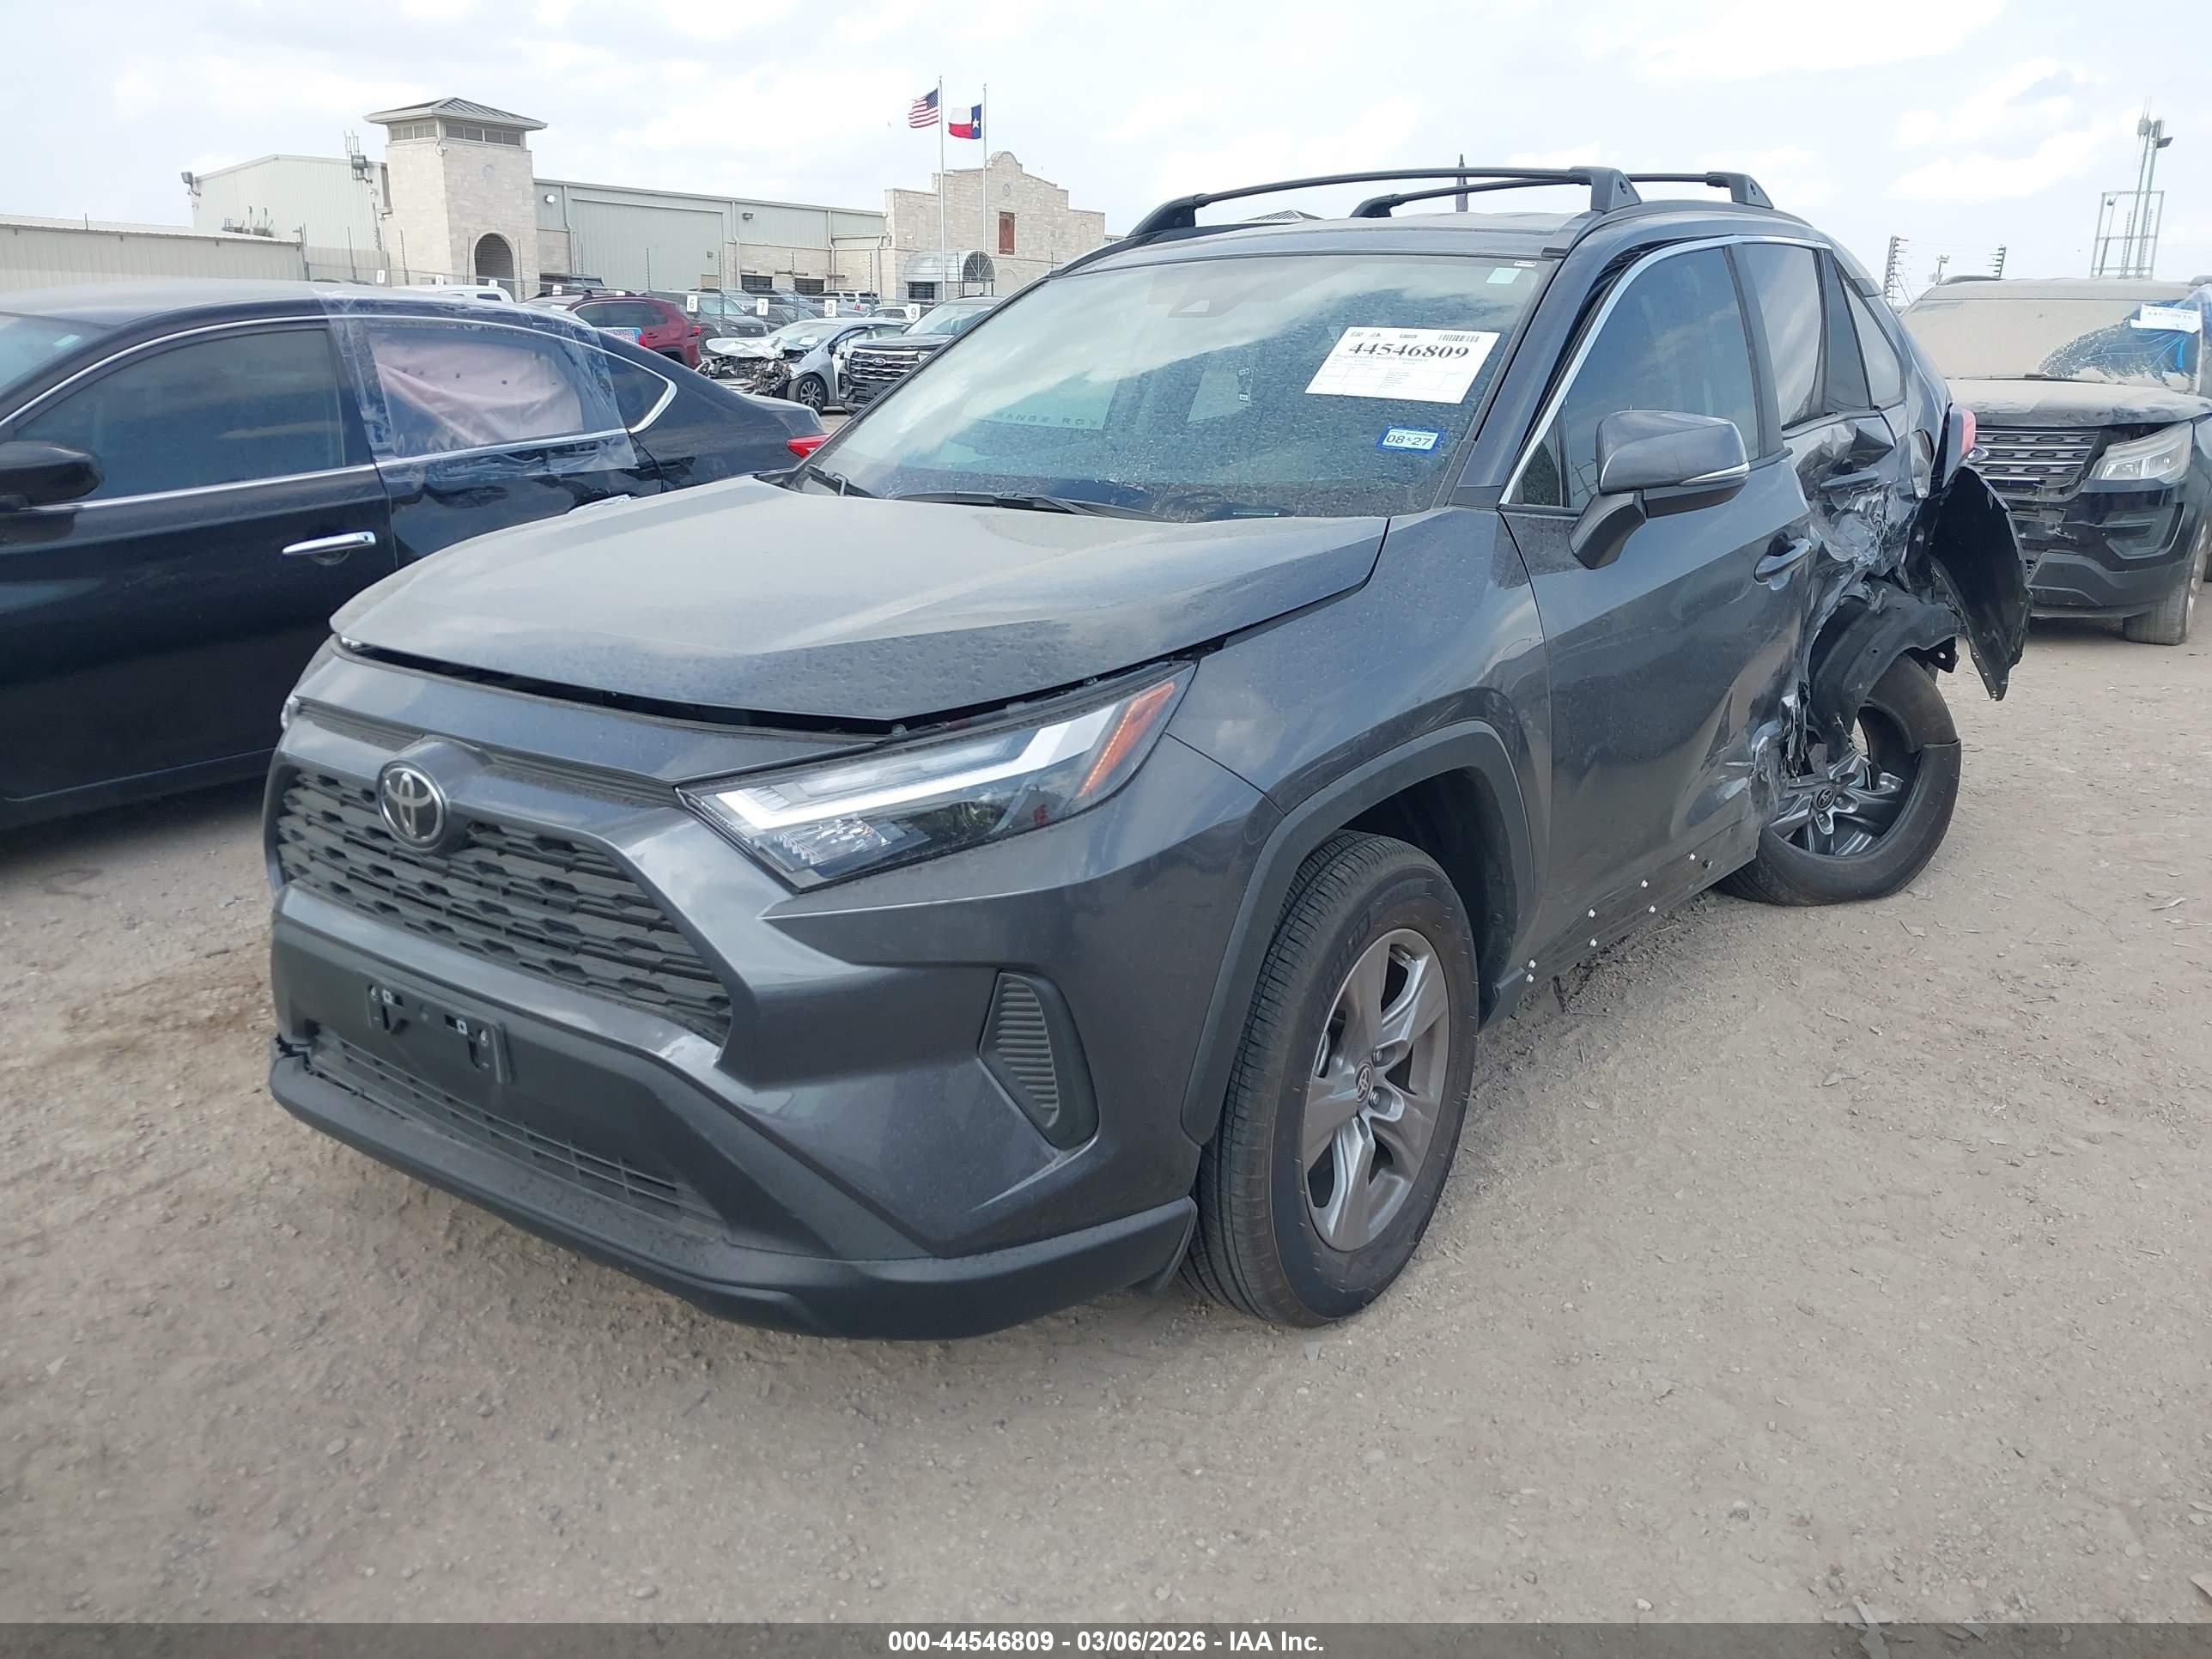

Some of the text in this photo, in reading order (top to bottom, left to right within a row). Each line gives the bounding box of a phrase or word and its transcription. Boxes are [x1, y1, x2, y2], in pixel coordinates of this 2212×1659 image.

[690, 298, 695, 309] 6
[761, 301, 766, 313] 7
[827, 302, 833, 314] 8
[910, 307, 917, 319] 9
[1347, 342, 1470, 360] 44546809
[1386, 434, 1431, 447] 08 27
